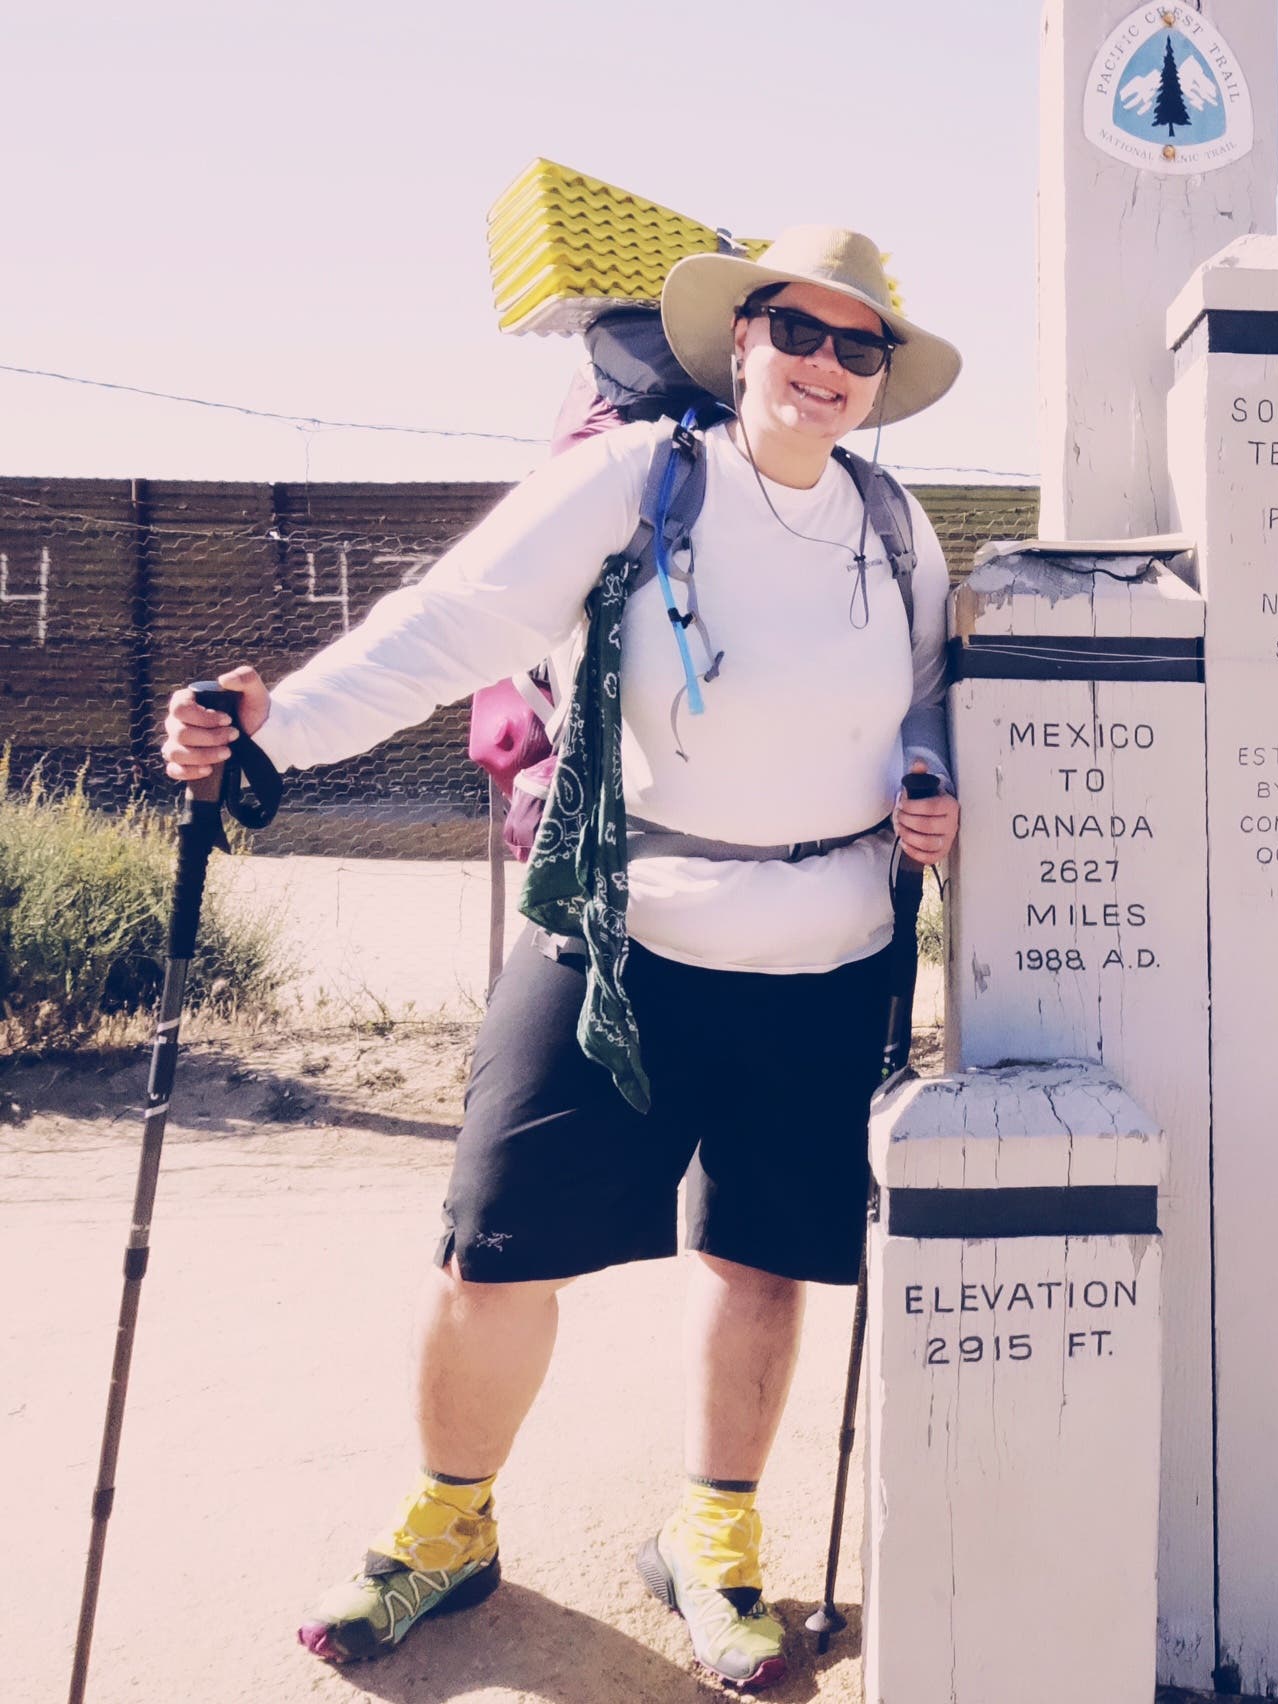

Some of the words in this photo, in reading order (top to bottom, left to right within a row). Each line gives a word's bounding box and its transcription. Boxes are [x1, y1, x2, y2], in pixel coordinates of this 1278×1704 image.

[1097, 24, 1140, 94] PACIFIC
[1209, 42, 1240, 103] TRAIL
[1100, 129, 1153, 160] NATIONAL
[1205, 141, 1238, 160] TRAIL
[1009, 722, 1154, 749] MEXICO
[1058, 768, 1105, 792] TO
[1012, 814, 1153, 839] CANADA
[1040, 860, 1119, 883] 2627
[1027, 903, 1146, 927] MILES
[1102, 948, 1160, 970] A.D.
[905, 1280, 1137, 1314] ELEVATION
[927, 1334, 1033, 1365] 2915
[1068, 1330, 1113, 1357] FT.
